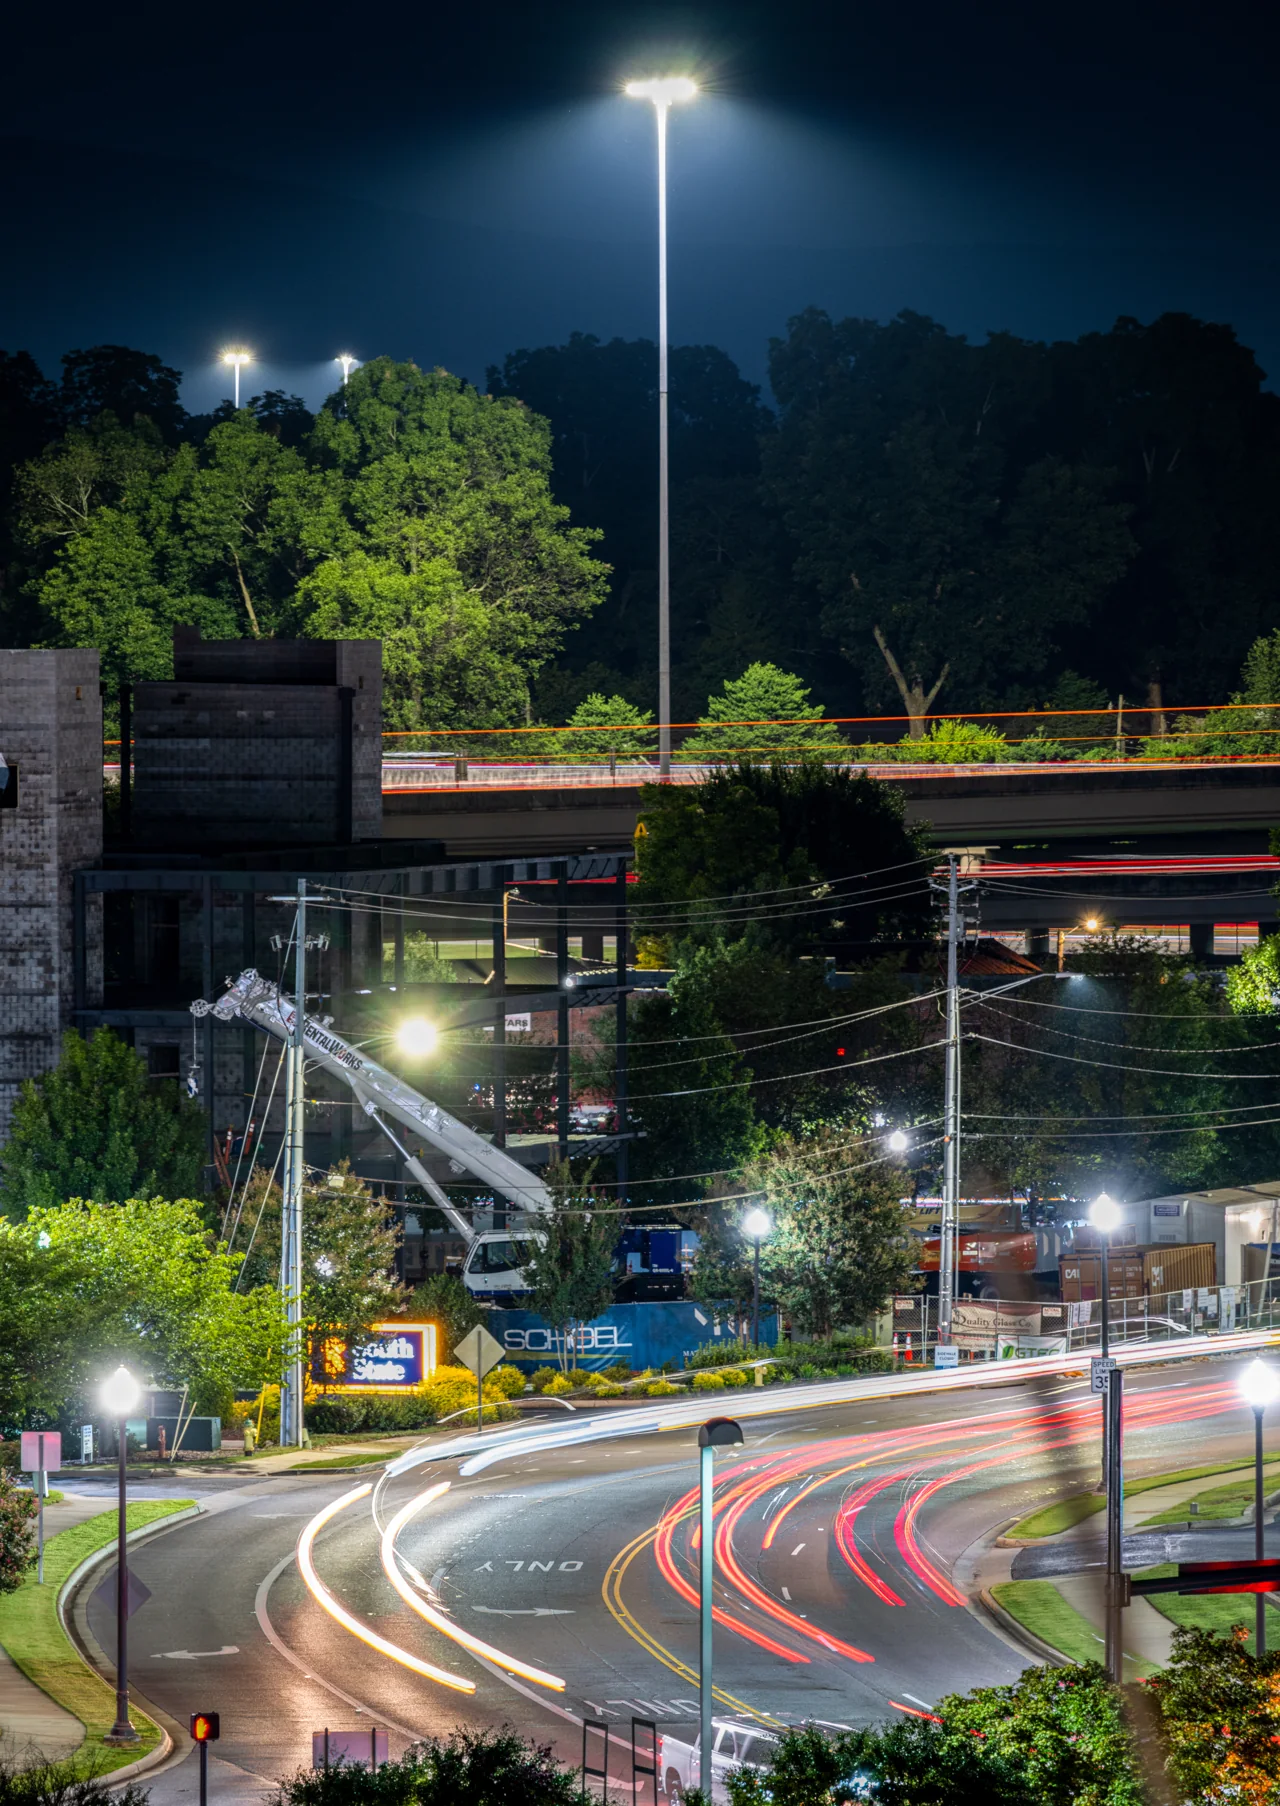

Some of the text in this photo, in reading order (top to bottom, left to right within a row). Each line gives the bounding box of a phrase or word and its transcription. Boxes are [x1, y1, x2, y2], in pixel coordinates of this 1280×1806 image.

[953, 1315, 991, 1329] Quality
[993, 1317, 1016, 1327] Glass
[473, 1560, 584, 1572] ONLY
[583, 1698, 700, 1716] ONLY
